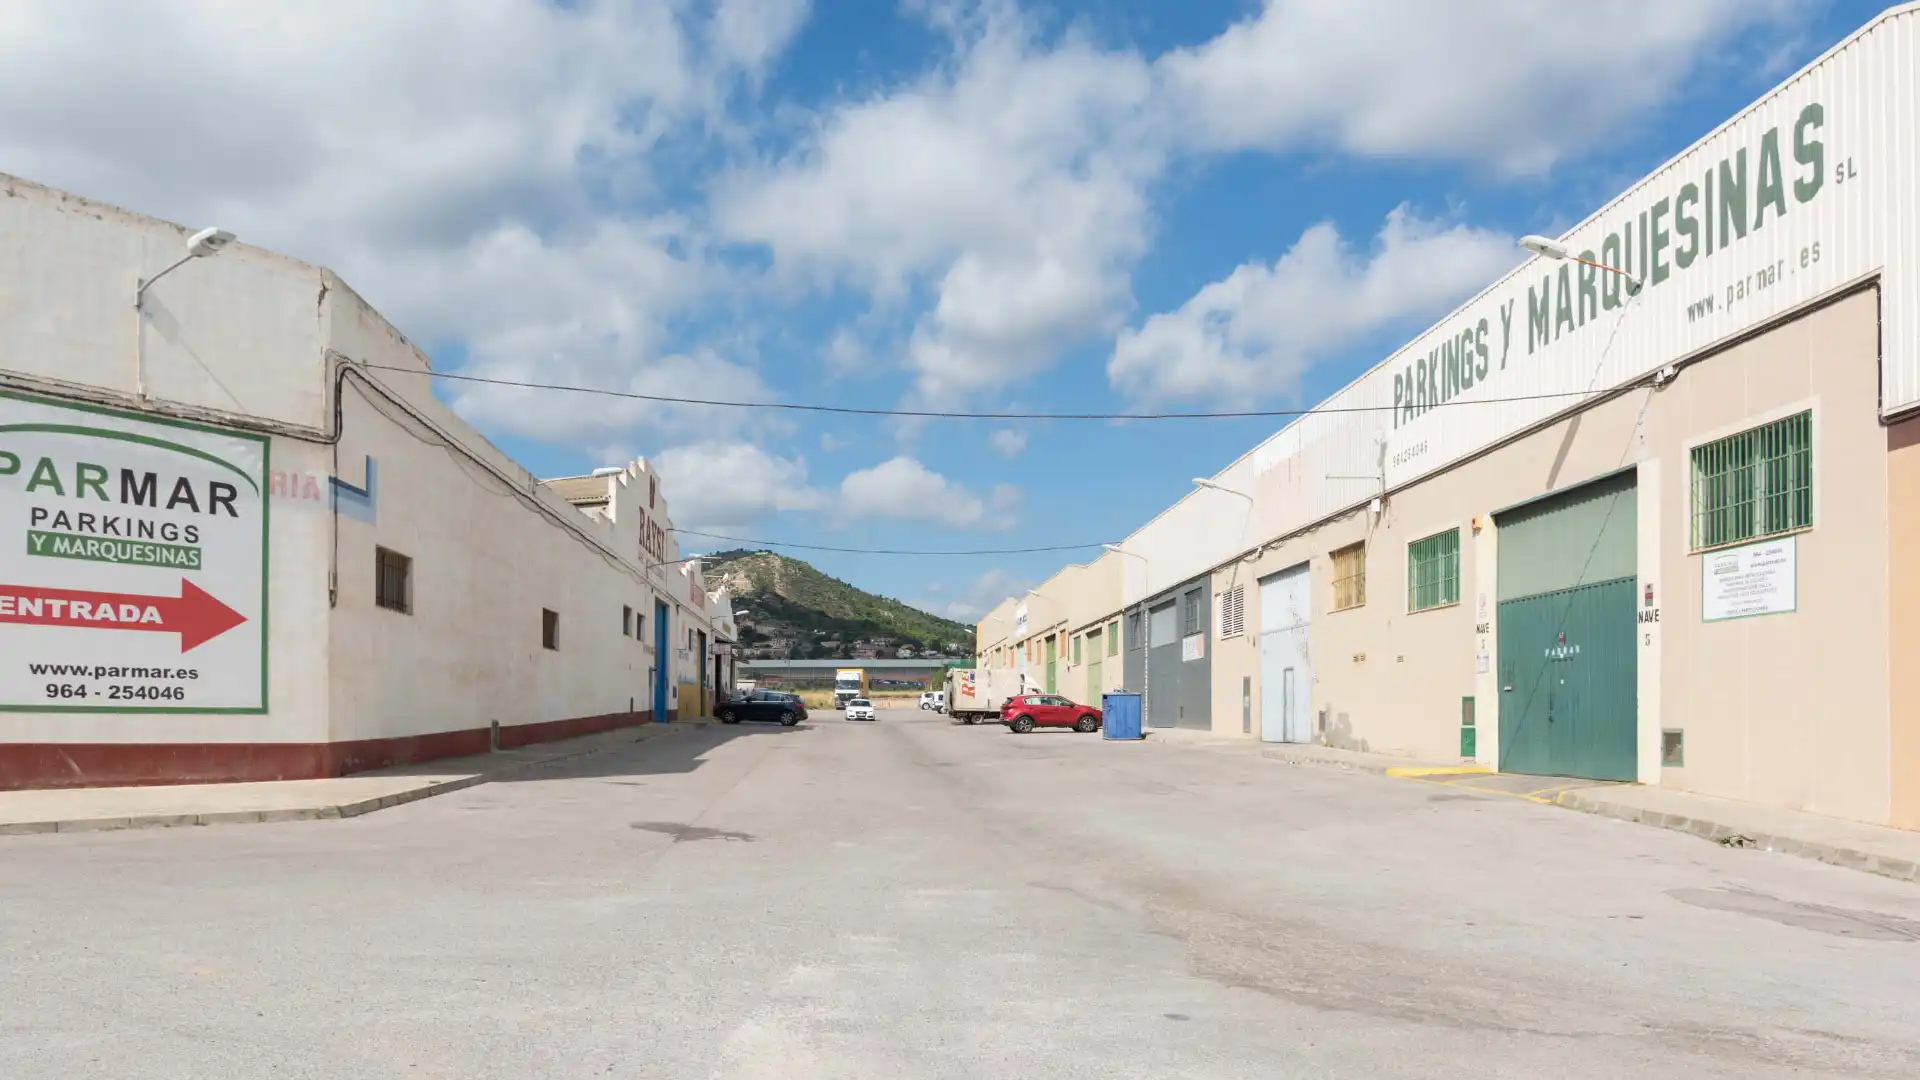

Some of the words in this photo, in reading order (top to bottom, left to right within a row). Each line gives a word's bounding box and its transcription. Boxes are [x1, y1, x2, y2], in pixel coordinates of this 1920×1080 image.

[1394, 318, 1488, 430] PARKINGS
[1500, 298, 1514, 370] Y
[1528, 102, 1824, 355] MARQUESINAS
[1836, 157, 1857, 184] SL
[1687, 241, 1820, 323] www.parmar.es
[31, 507, 199, 544] PARKINGS
[31, 534, 47, 552] Y
[53, 536, 199, 566] MARQUESINAS
[0, 596, 163, 624] ENTRADA
[1638, 609, 1660, 624] NAVE
[29, 663, 199, 680] www.parmar.es
[46, 684, 87, 699] 964
[108, 685, 185, 701] 254046
